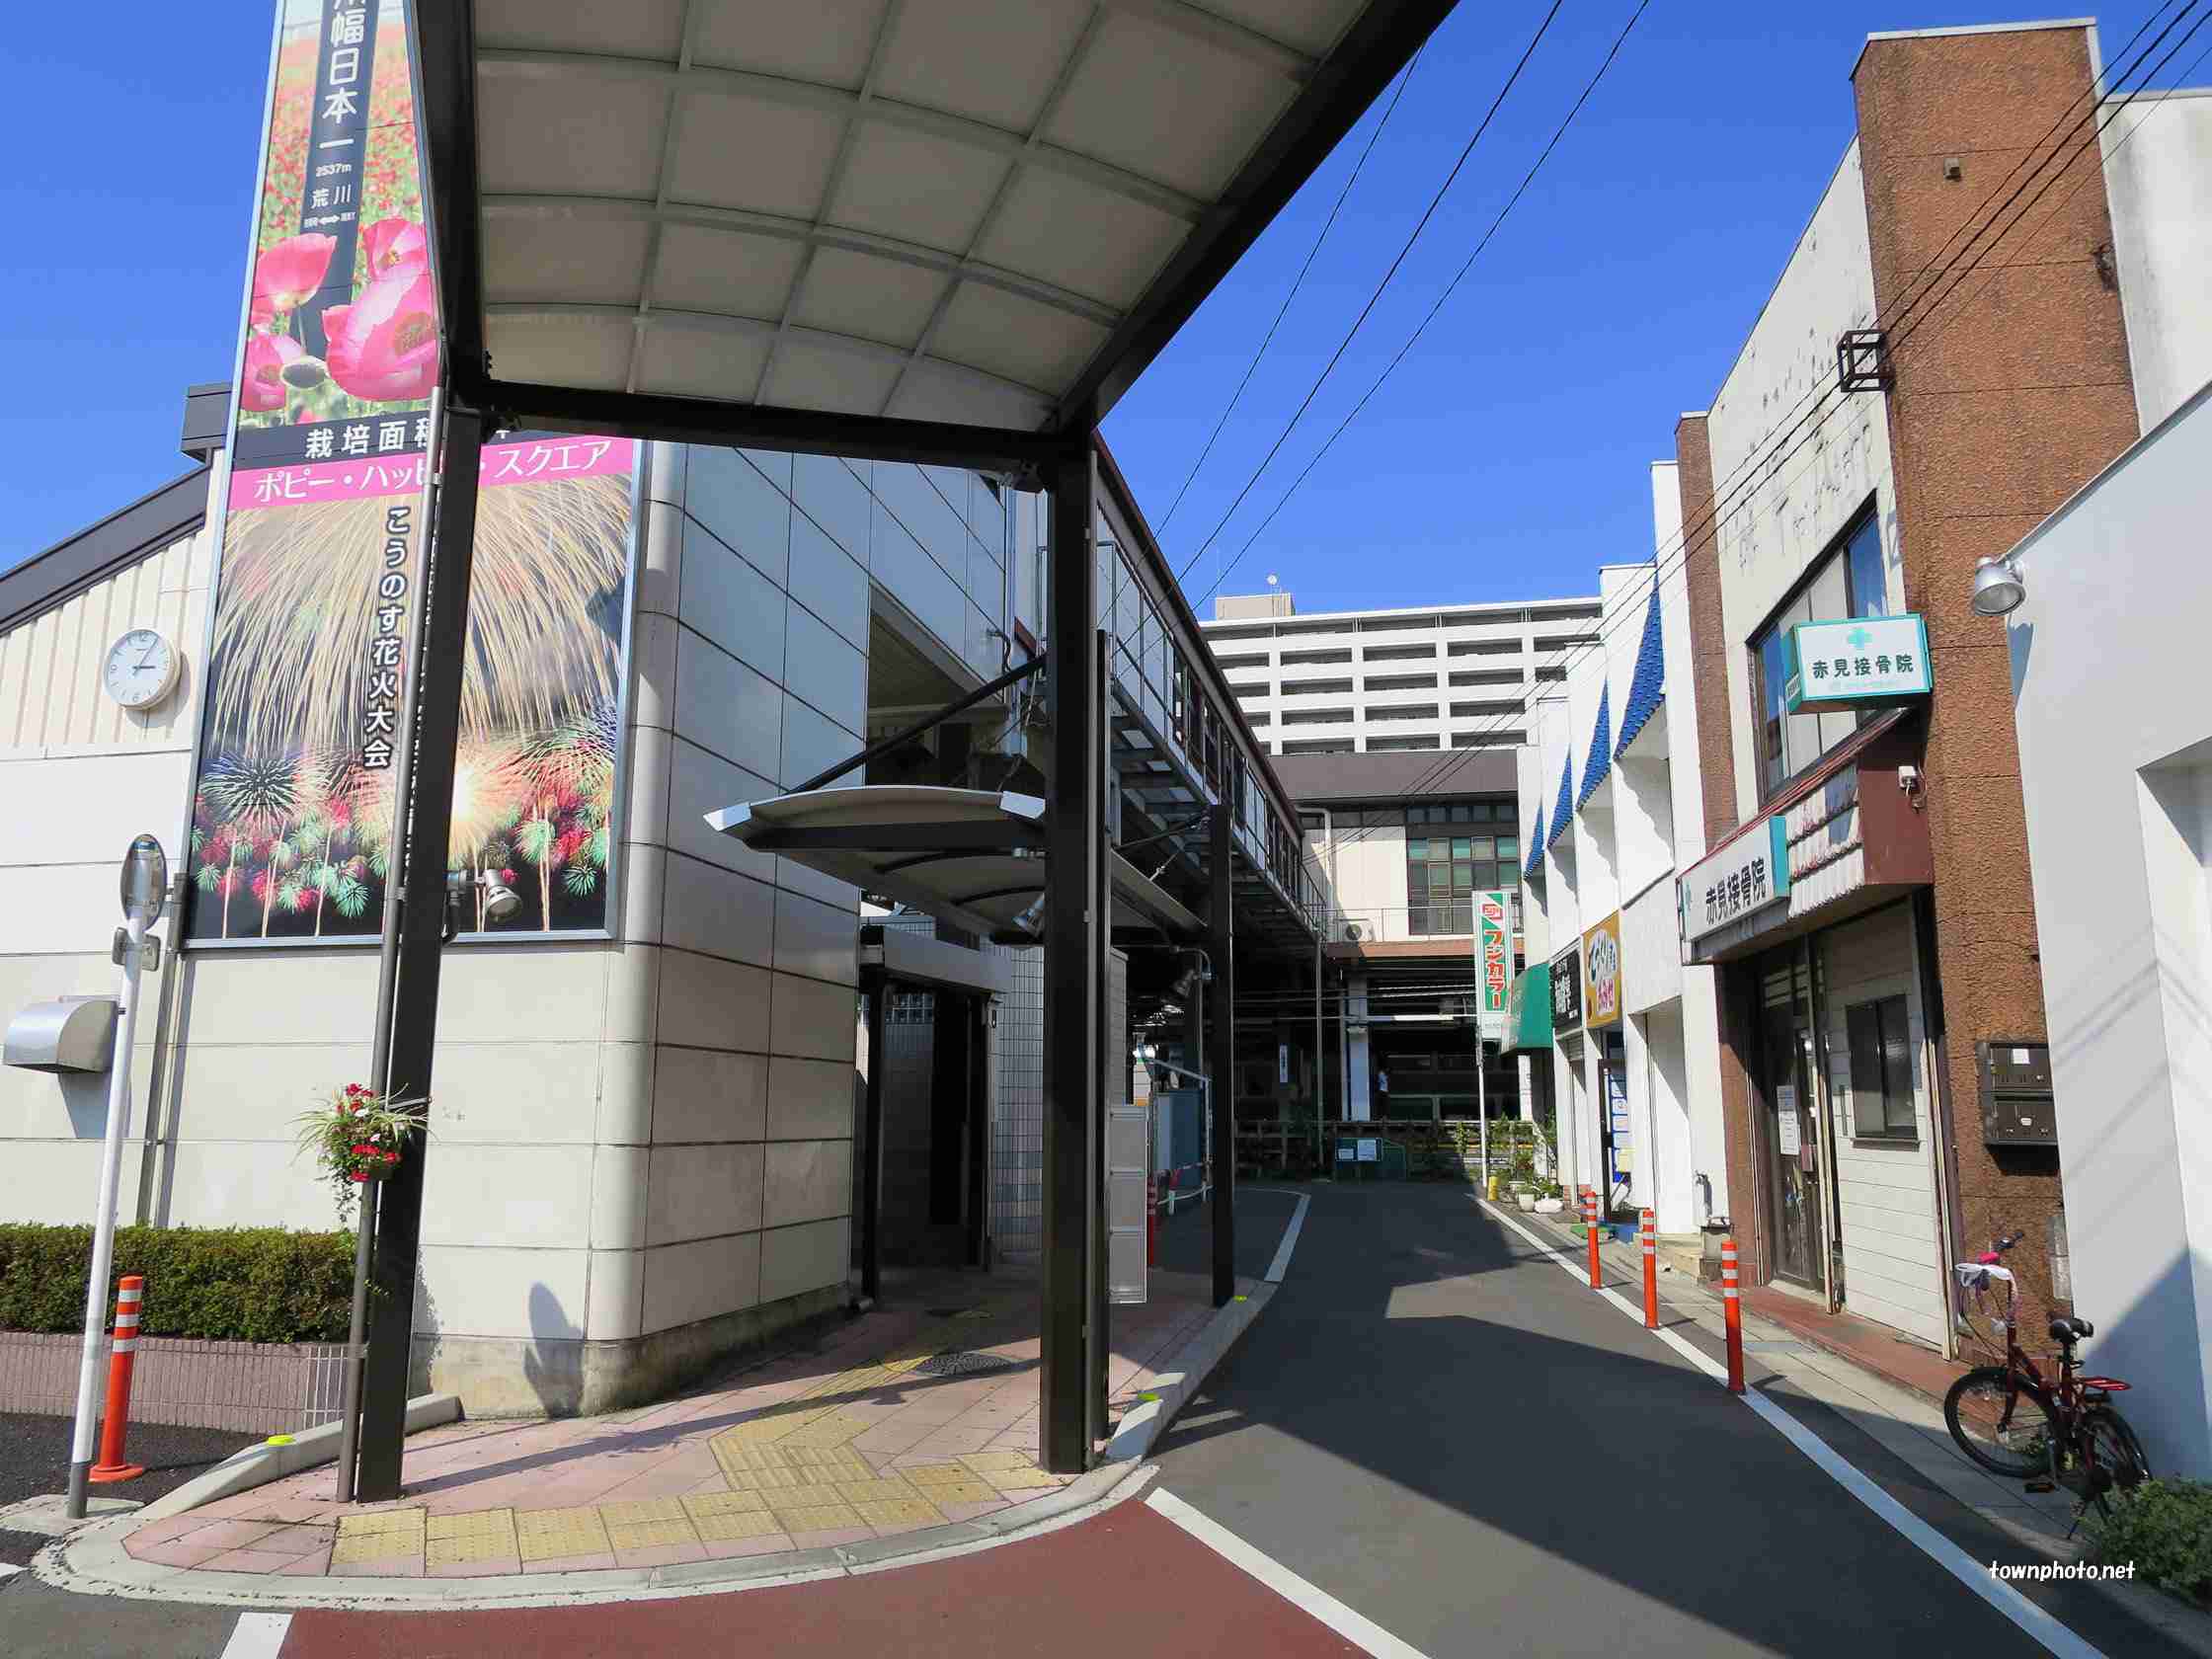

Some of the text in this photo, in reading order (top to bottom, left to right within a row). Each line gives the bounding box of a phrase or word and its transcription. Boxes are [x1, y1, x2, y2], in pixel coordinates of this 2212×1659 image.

[315, 163, 352, 177] 2537m
[311, 185, 352, 208] 荒川
[363, 506, 411, 769] こうのす花火大会
[1812, 654, 1914, 679] 赤見接骨院
[1705, 856, 1766, 925] 赤見接骨院
[1484, 929, 1506, 1009] フジカラー
